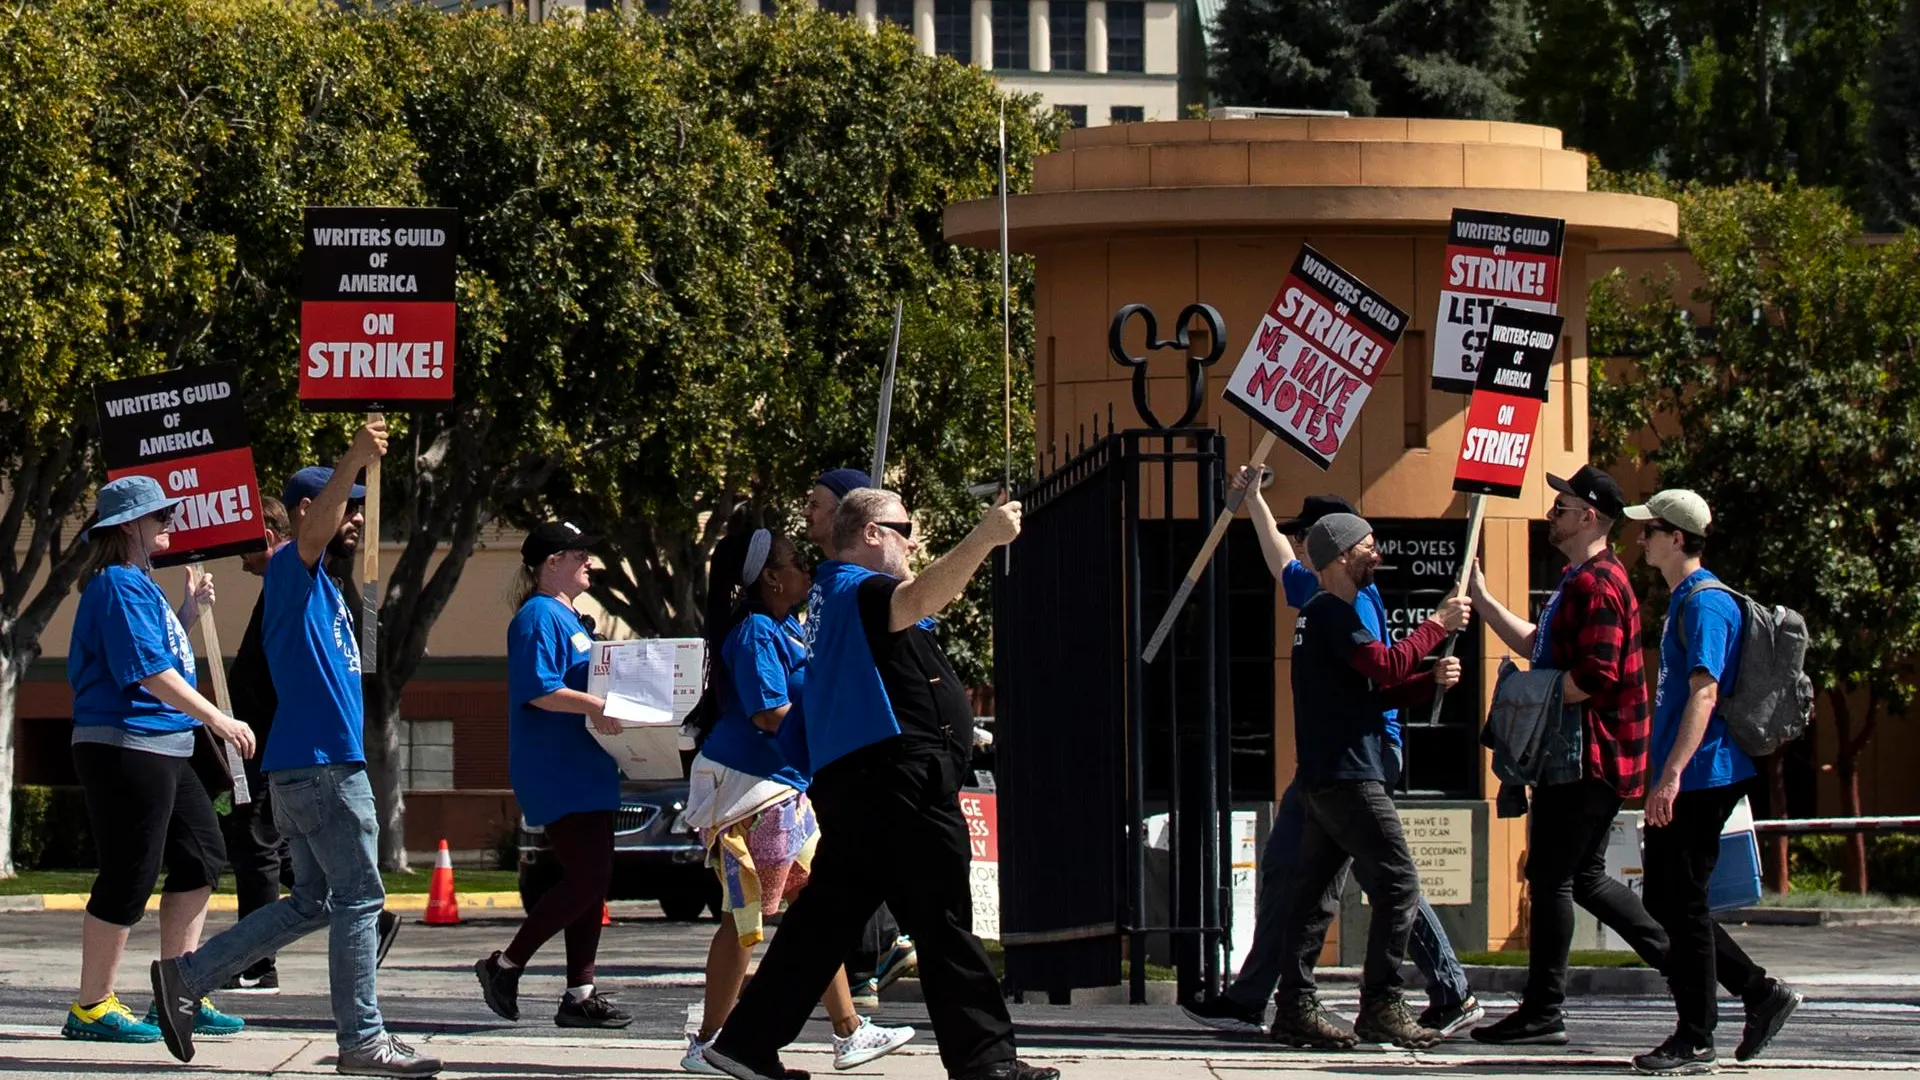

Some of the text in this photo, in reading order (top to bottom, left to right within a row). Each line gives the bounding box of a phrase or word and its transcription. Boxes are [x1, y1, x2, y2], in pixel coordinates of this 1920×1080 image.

[313, 228, 446, 247] WRITERS GUILD
[1456, 222, 1550, 247] WRITERS GUILD
[369, 252, 389, 268] OF
[1493, 244, 1507, 257] ON
[338, 274, 418, 293] AMERICA
[1450, 254, 1546, 296] STRIKE!
[1302, 254, 1400, 332] WRITERS GUILD
[1334, 301, 1350, 318] ON
[363, 313, 394, 335] ON
[1277, 287, 1384, 376] STRIKE!
[1492, 324, 1554, 350] WRITERS GUILD
[308, 341, 444, 379] STRIKE!
[1513, 350, 1525, 365] OF
[1255, 321, 1361, 418] WE HAVE
[1494, 368, 1532, 389] AMERICA
[105, 381, 231, 418] WRITERS GUILD
[1246, 362, 1344, 455] NOTES
[163, 412, 181, 429] OF
[1497, 404, 1516, 426] ON
[139, 428, 214, 457] AMERICA
[1462, 427, 1531, 469] STRIKE!
[168, 467, 199, 491] ON
[167, 485, 253, 533] RIKE!
[1376, 540, 1456, 556] MPLOYEES
[1411, 560, 1455, 576] ONLY
[960, 798, 983, 817] GE
[967, 819, 990, 837] ESS
[1414, 817, 1436, 827] HAVE
[1414, 828, 1425, 837] TO
[1429, 828, 1450, 837] SCAN
[971, 840, 987, 858] LY
[1420, 847, 1467, 856] OCCUPANTS
[1414, 859, 1432, 867] CAN
[1427, 889, 1458, 897] SEARCH
[975, 919, 999, 935] ATE
